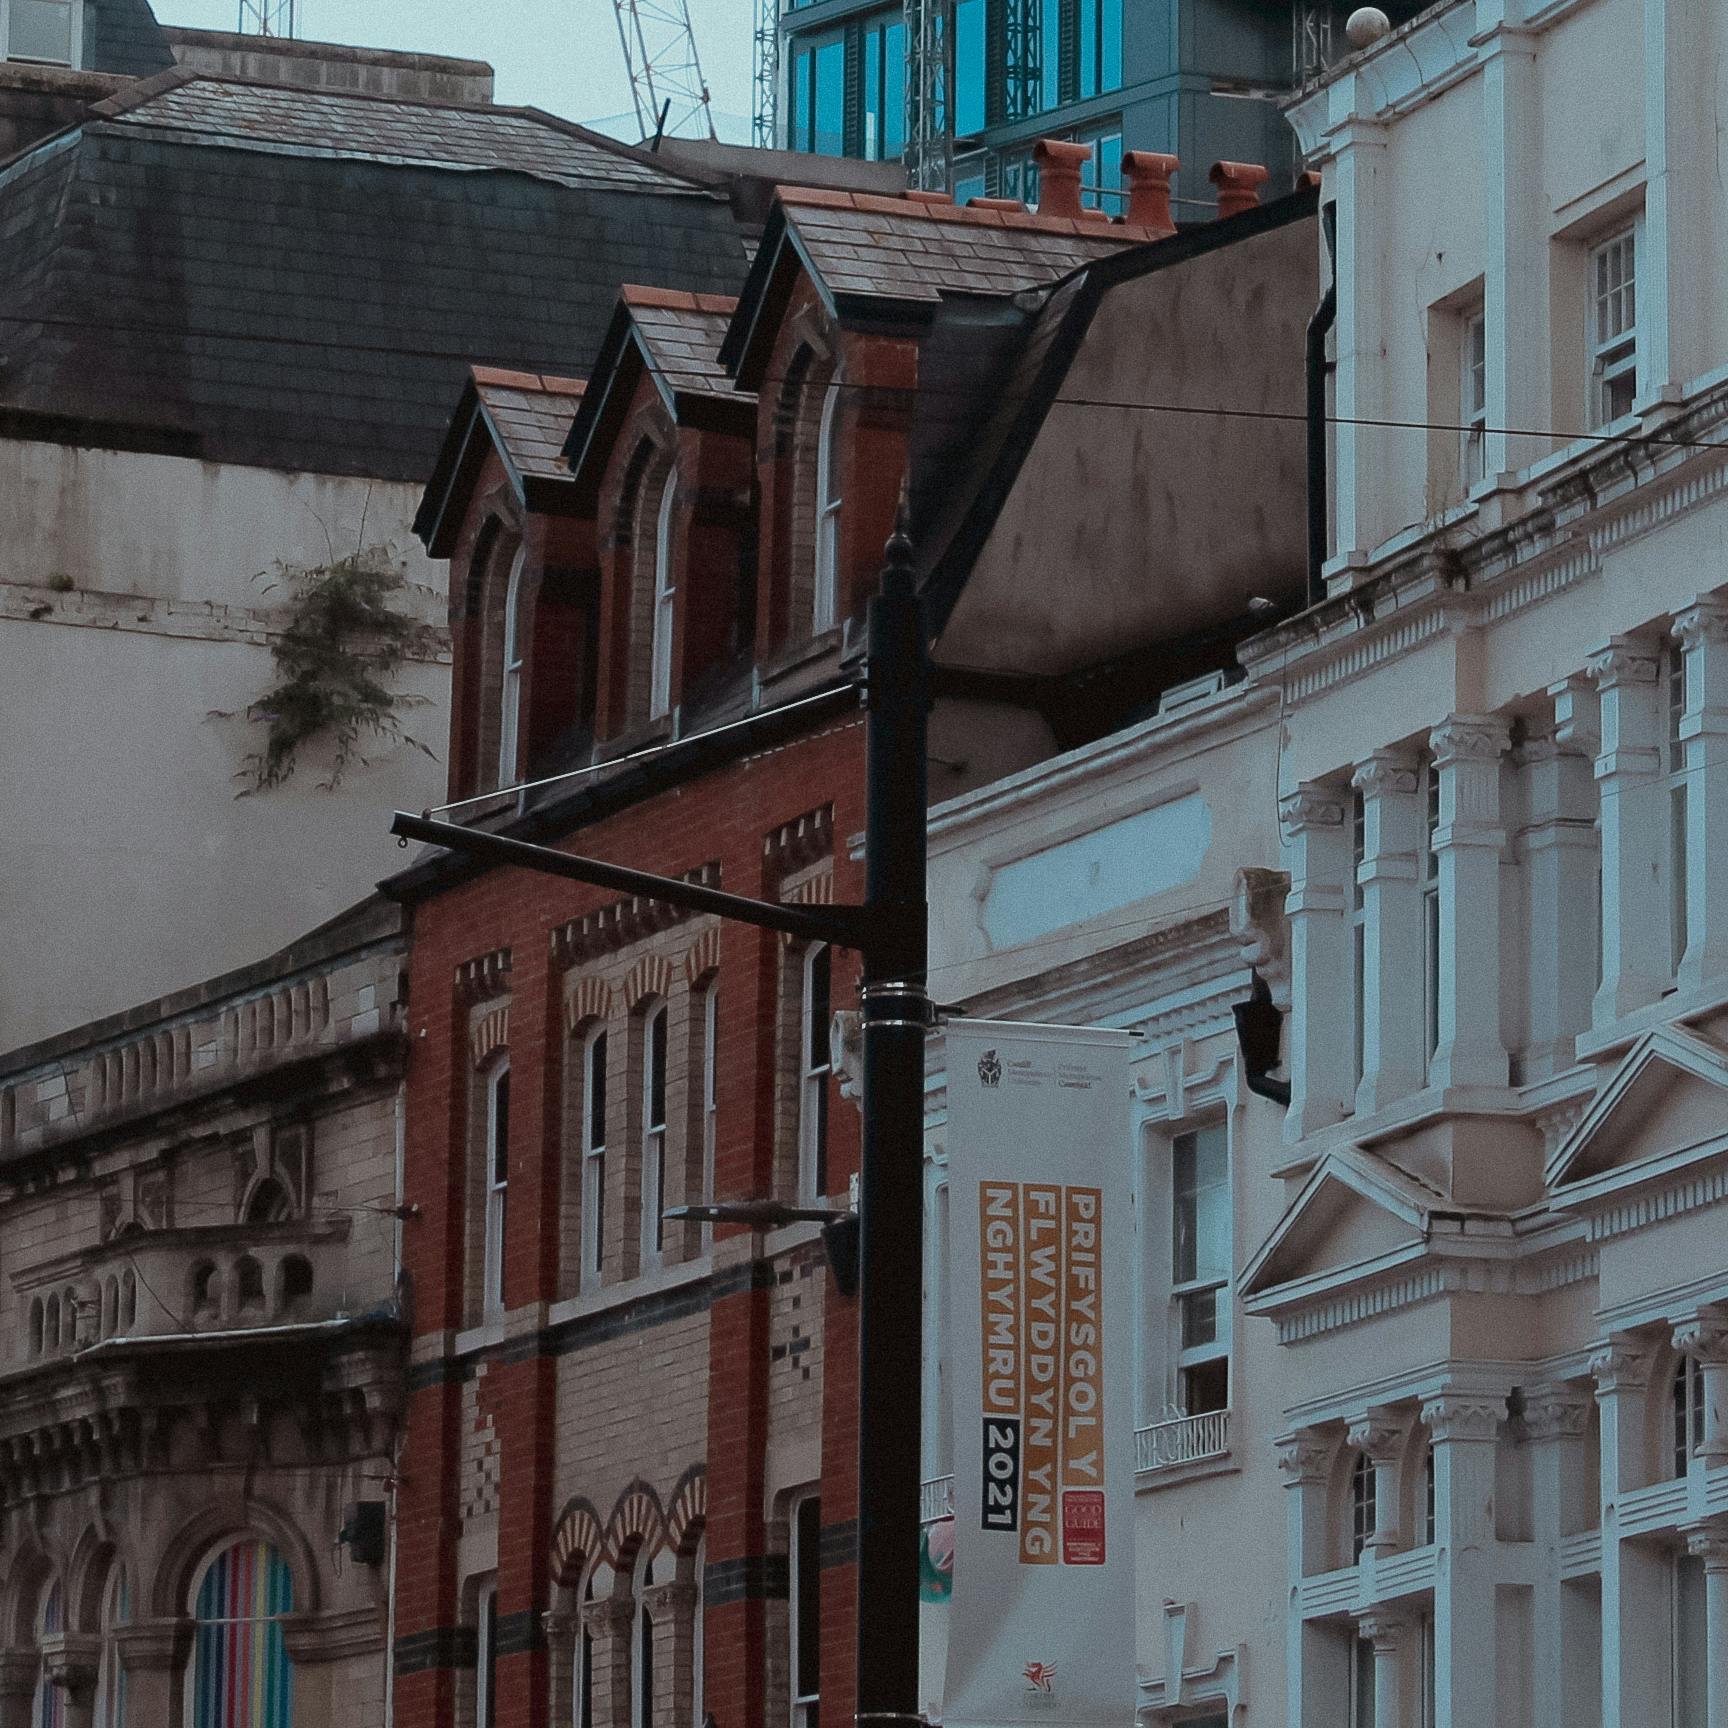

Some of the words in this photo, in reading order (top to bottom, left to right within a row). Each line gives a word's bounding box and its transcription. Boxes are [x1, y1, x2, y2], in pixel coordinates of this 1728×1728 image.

[986, 1189, 1015, 1406] NGHYMRU
[1029, 1191, 1056, 1446] FLWYDDYN
[1069, 1194, 1096, 1439] PRIFYSGOL
[987, 1424, 1015, 1524] 2021
[1025, 1463, 1051, 1555] YNG
[1069, 1450, 1098, 1478] Y
